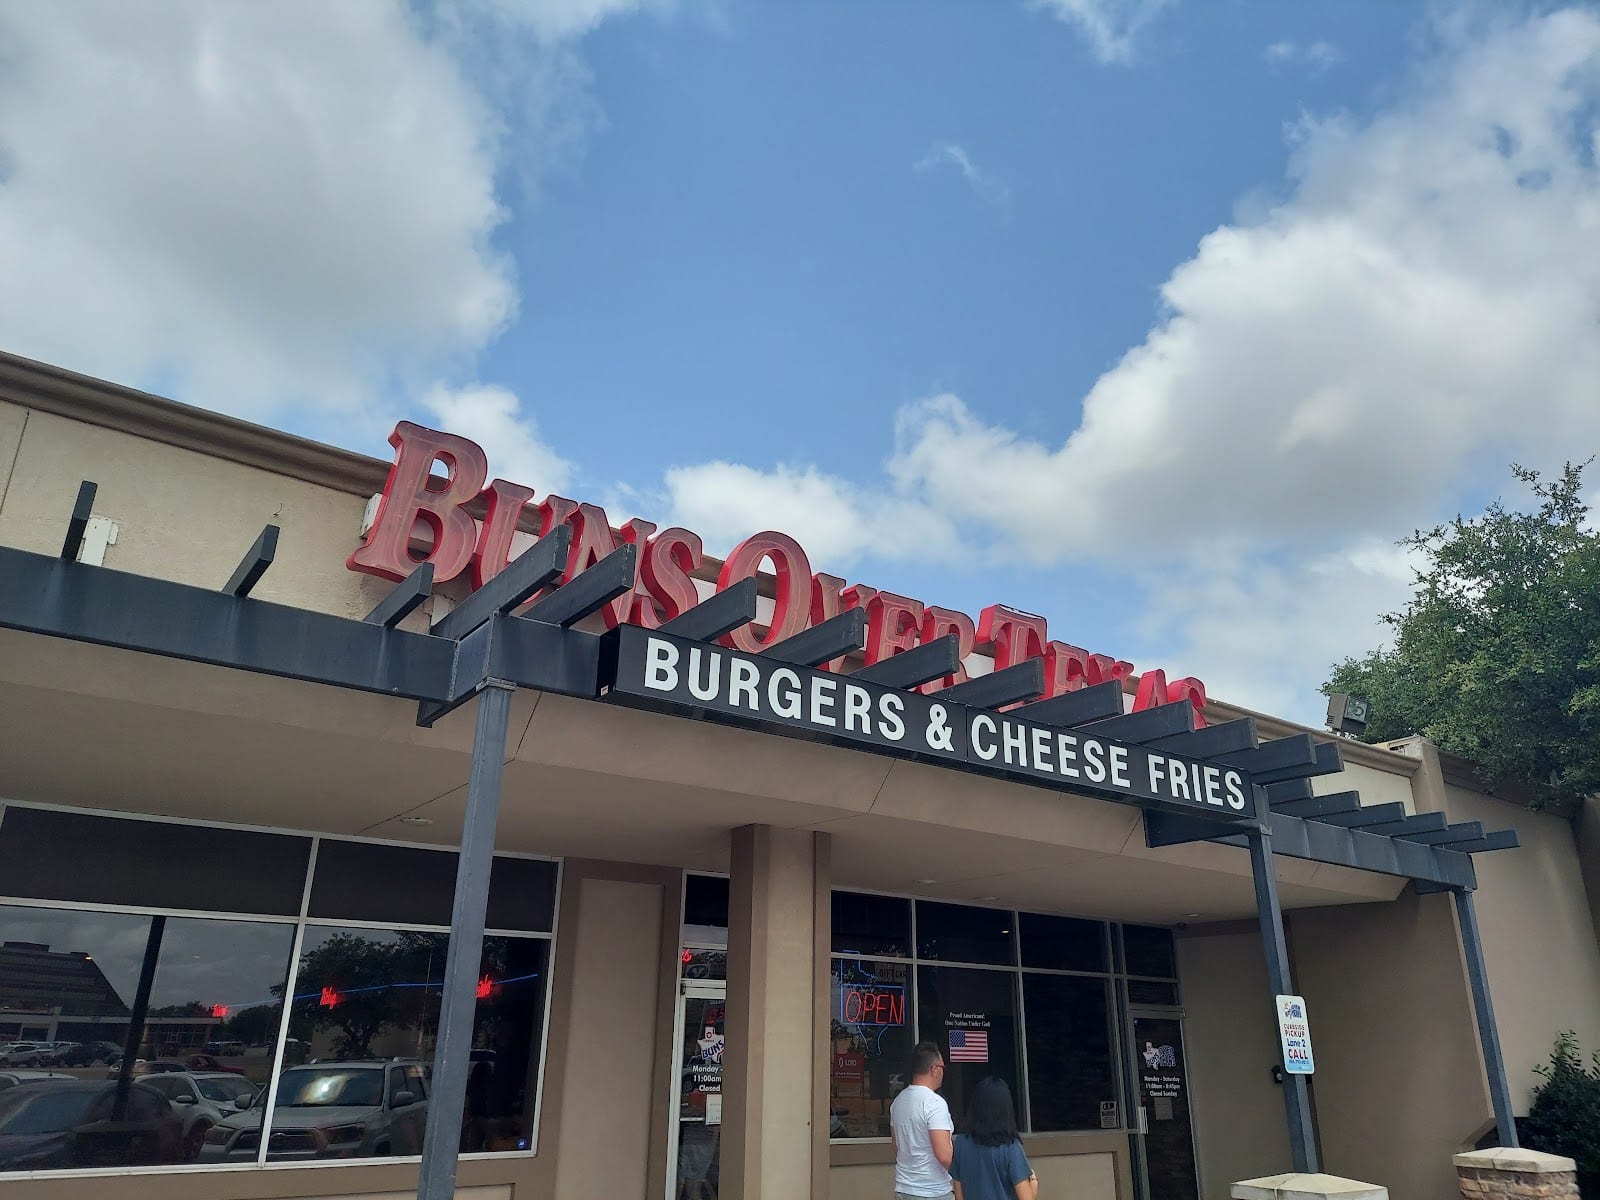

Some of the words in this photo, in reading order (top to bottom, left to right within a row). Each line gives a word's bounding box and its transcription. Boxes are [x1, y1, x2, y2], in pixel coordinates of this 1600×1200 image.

[346, 420, 703, 632] BUNS
[715, 531, 975, 695] OVER
[644, 637, 906, 742] BURGERS
[925, 703, 954, 752] &
[971, 714, 1131, 788] CHEESE
[1147, 753, 1245, 811] FRIES
[845, 991, 904, 1025] OPEN
[1284, 1030, 1305, 1038] PICKUP
[1287, 1038, 1301, 1047] Lane
[1301, 1039, 1306, 1047] 2
[702, 1040, 725, 1059] BUNS
[1288, 1048, 1308, 1060] CALL
[692, 1065, 719, 1074] Monday
[693, 1074, 721, 1083] 11:00am
[699, 1084, 721, 1092] Closed
[1163, 1090, 1178, 1098] Sunday
